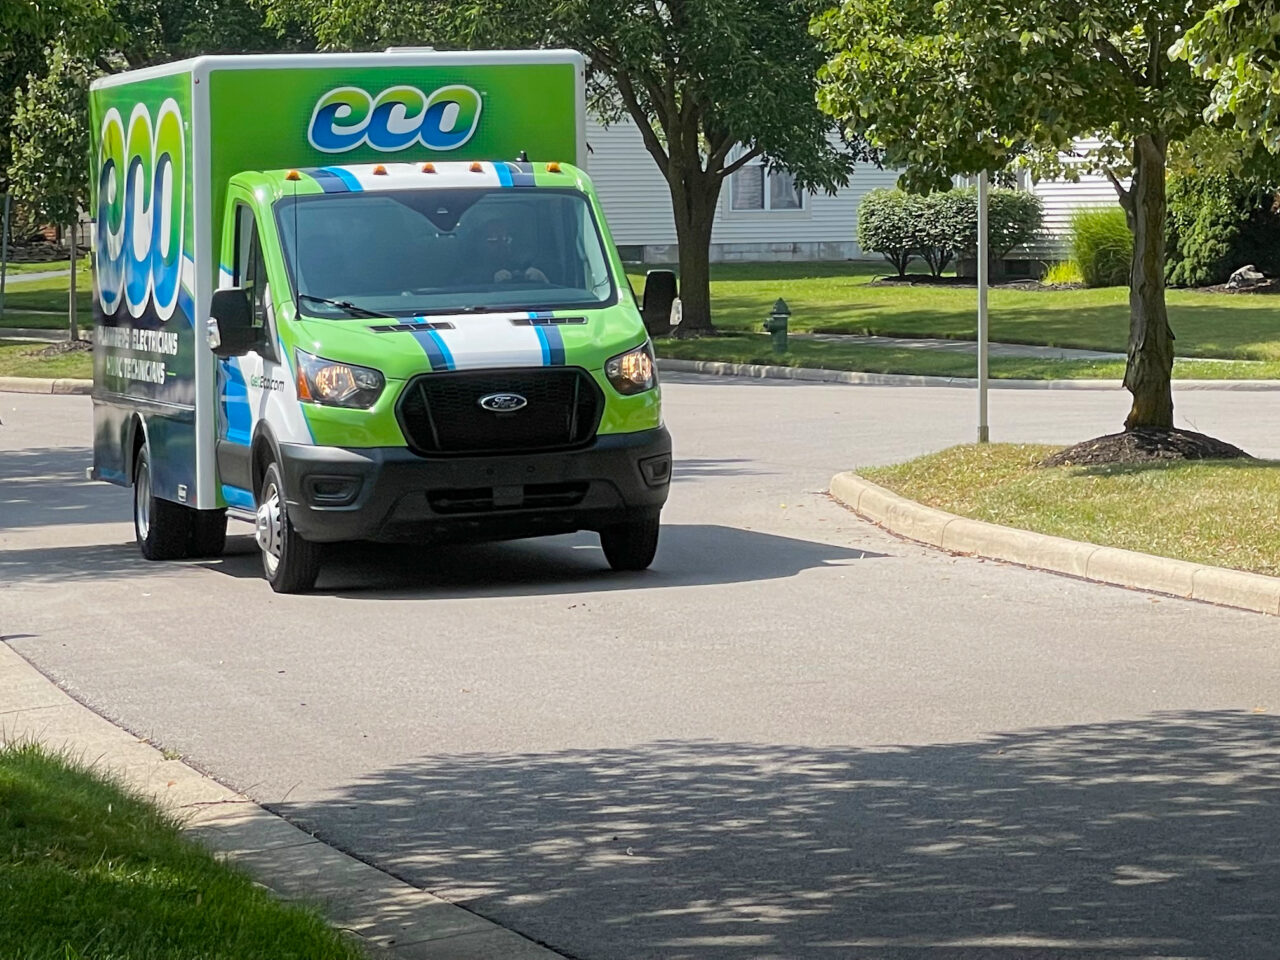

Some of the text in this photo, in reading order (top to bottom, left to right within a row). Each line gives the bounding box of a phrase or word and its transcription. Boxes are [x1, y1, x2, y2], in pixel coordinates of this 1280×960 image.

[308, 85, 482, 153] eco
[96, 98, 185, 321] eco
[132, 328, 178, 355] ELECTRICIANS
[124, 357, 165, 385] TECHNICIANS
